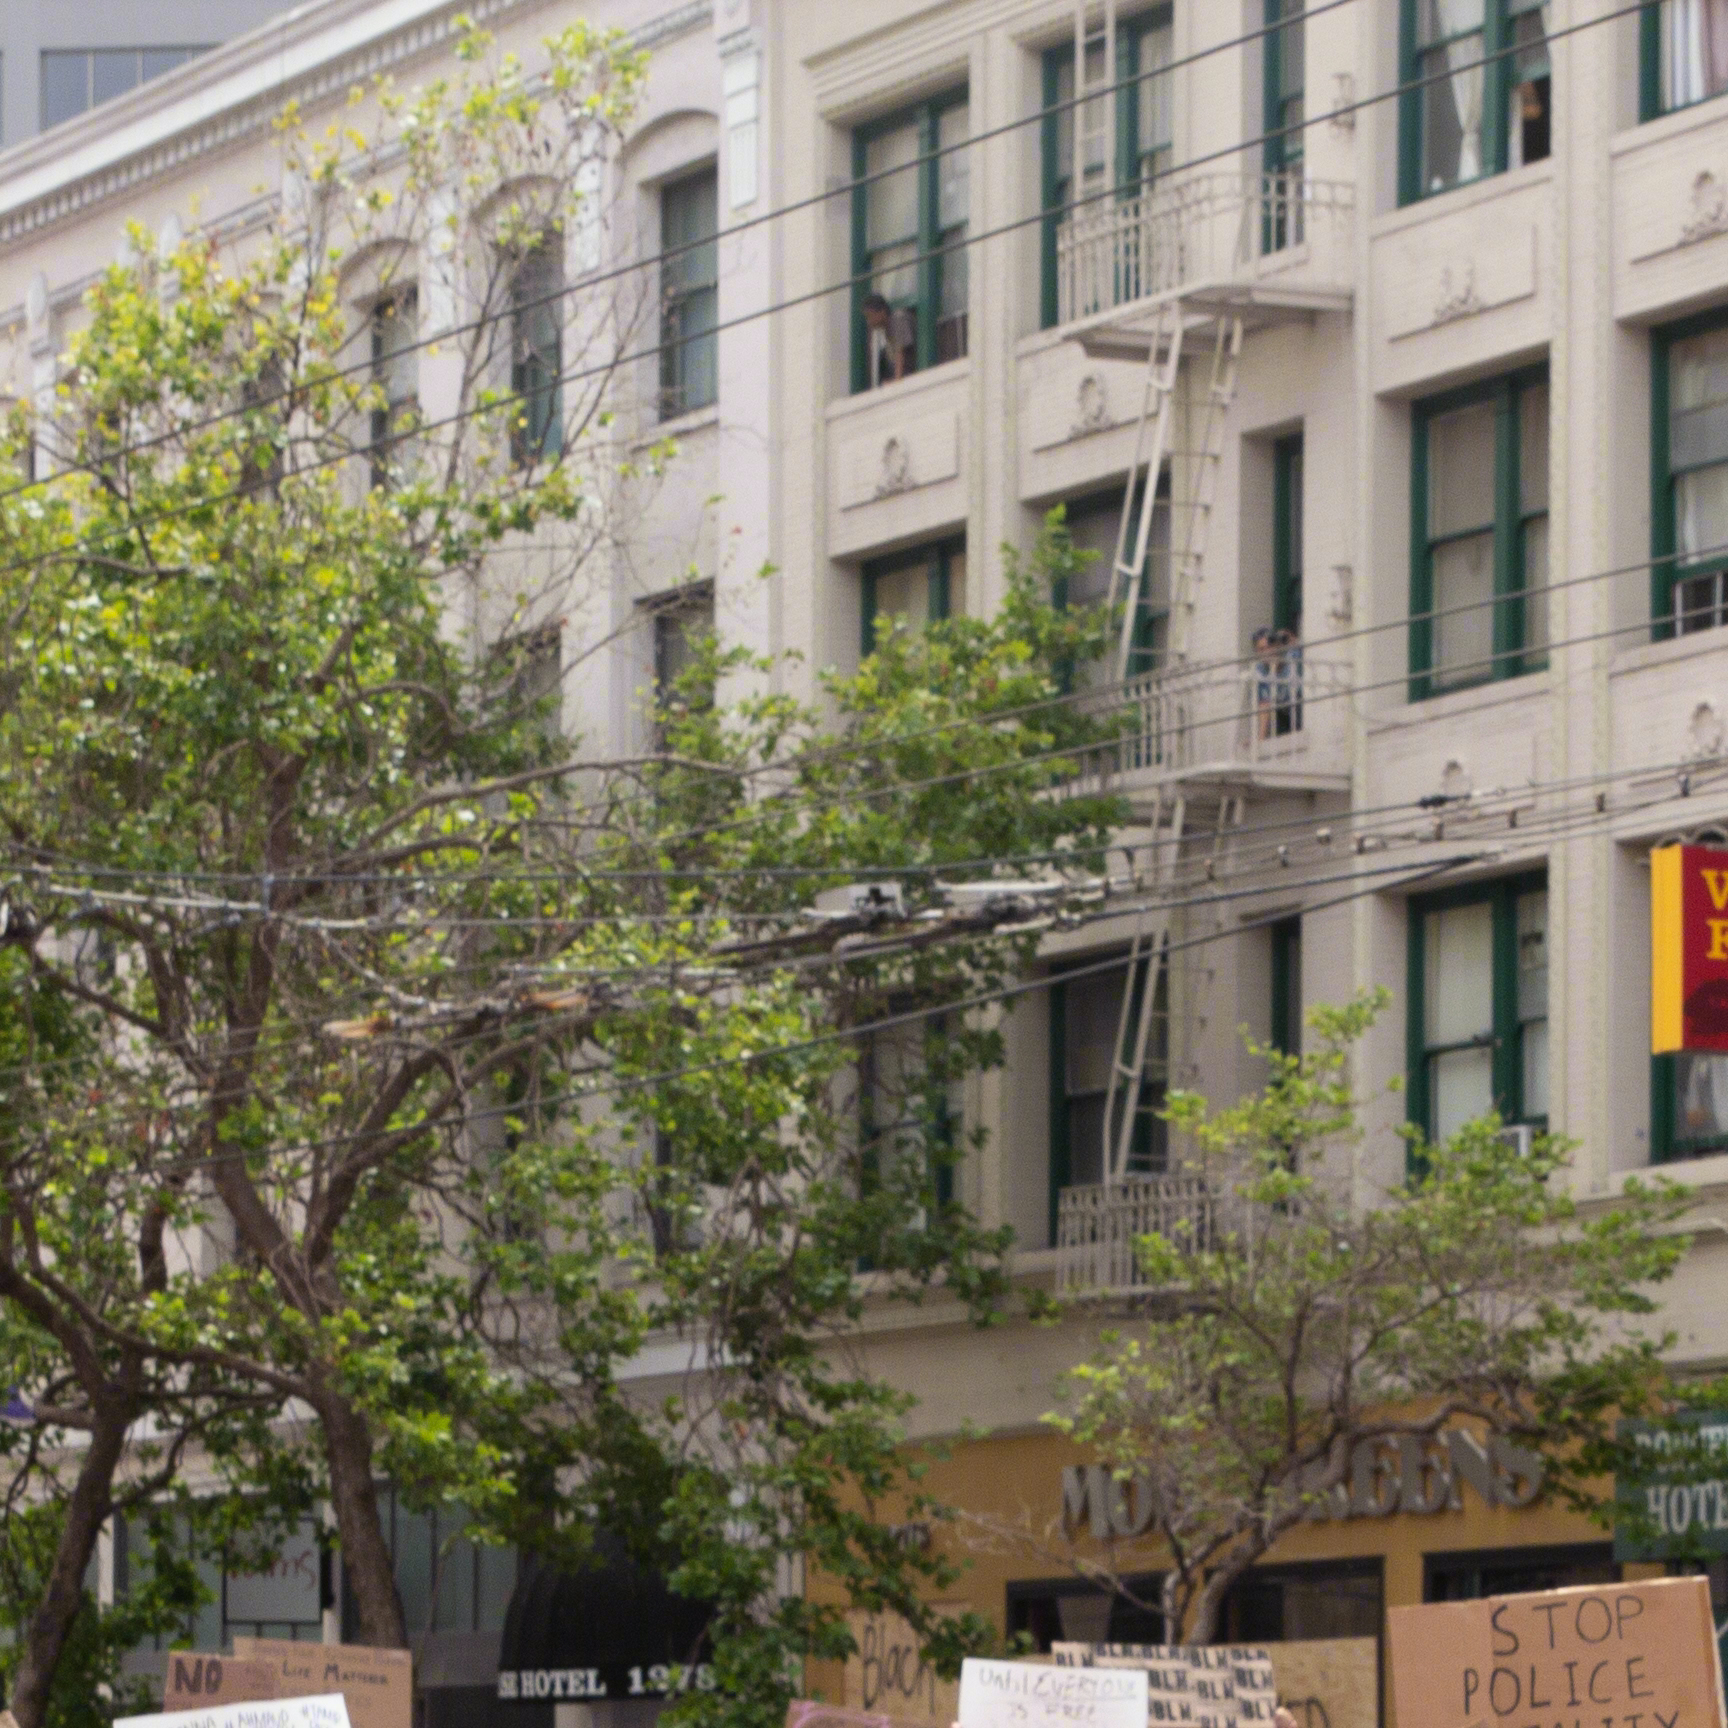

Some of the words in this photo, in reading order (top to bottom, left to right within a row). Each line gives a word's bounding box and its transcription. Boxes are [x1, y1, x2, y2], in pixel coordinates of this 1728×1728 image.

[1491, 1595, 1645, 1657] STOP
[174, 1657, 223, 1695] NO
[520, 1667, 607, 1698] HOTEL
[1465, 1656, 1655, 1716] POLICE
